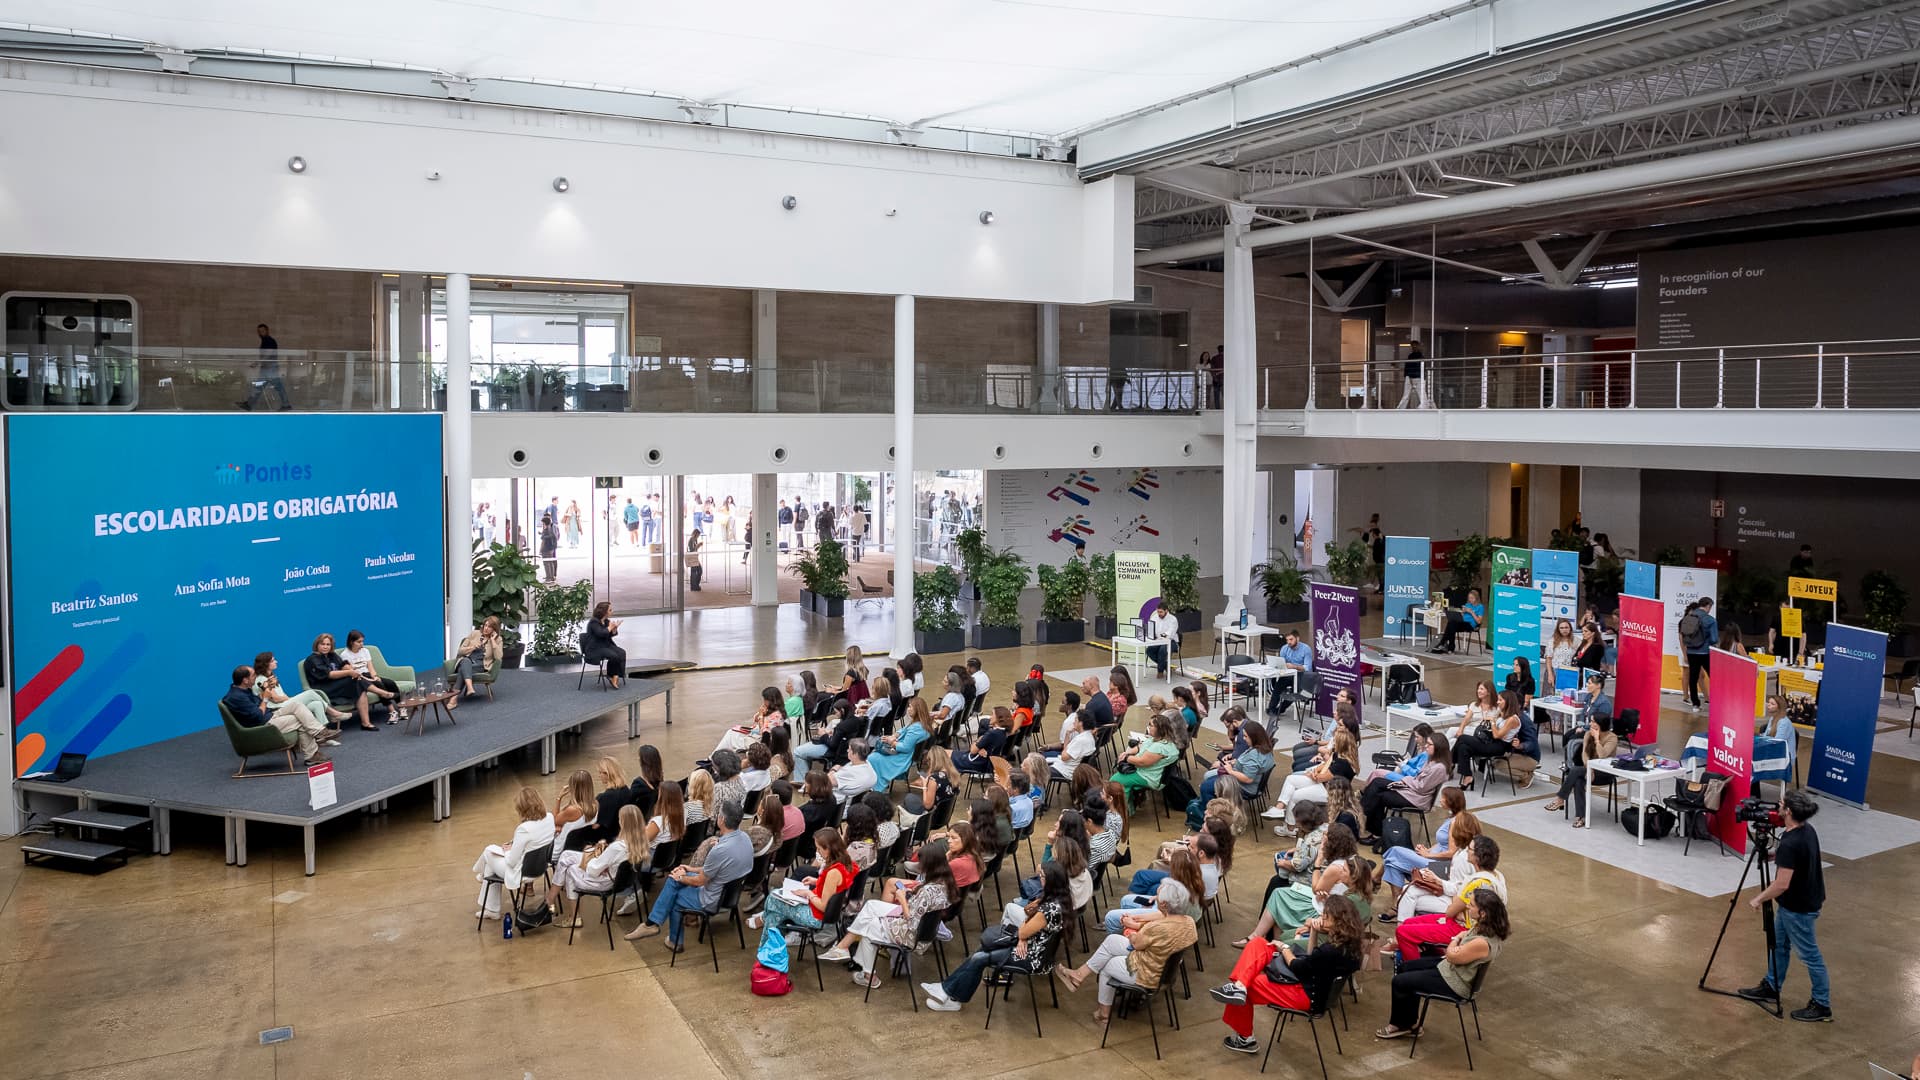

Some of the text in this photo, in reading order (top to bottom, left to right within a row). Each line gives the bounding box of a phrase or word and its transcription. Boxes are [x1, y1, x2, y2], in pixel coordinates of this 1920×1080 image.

[1660, 267, 1765, 284] In recognition of our
[1659, 285, 1708, 297] Founders
[245, 461, 312, 483] Pontes
[94, 488, 398, 537] ESCOLARIDADE OBRIGATÓRIA
[1738, 527, 1796, 540] Academic Hall
[364, 551, 416, 568] Paula Nicolau
[283, 564, 331, 582] João Costa
[174, 575, 250, 597] Ana Sofia Mota
[1804, 583, 1834, 596] JOYEUX
[51, 592, 139, 615] Beatriz Santos
[1314, 589, 1355, 603] Peer2Peer
[1622, 620, 1641, 632] SANTA
[1641, 624, 1657, 635] CASA
